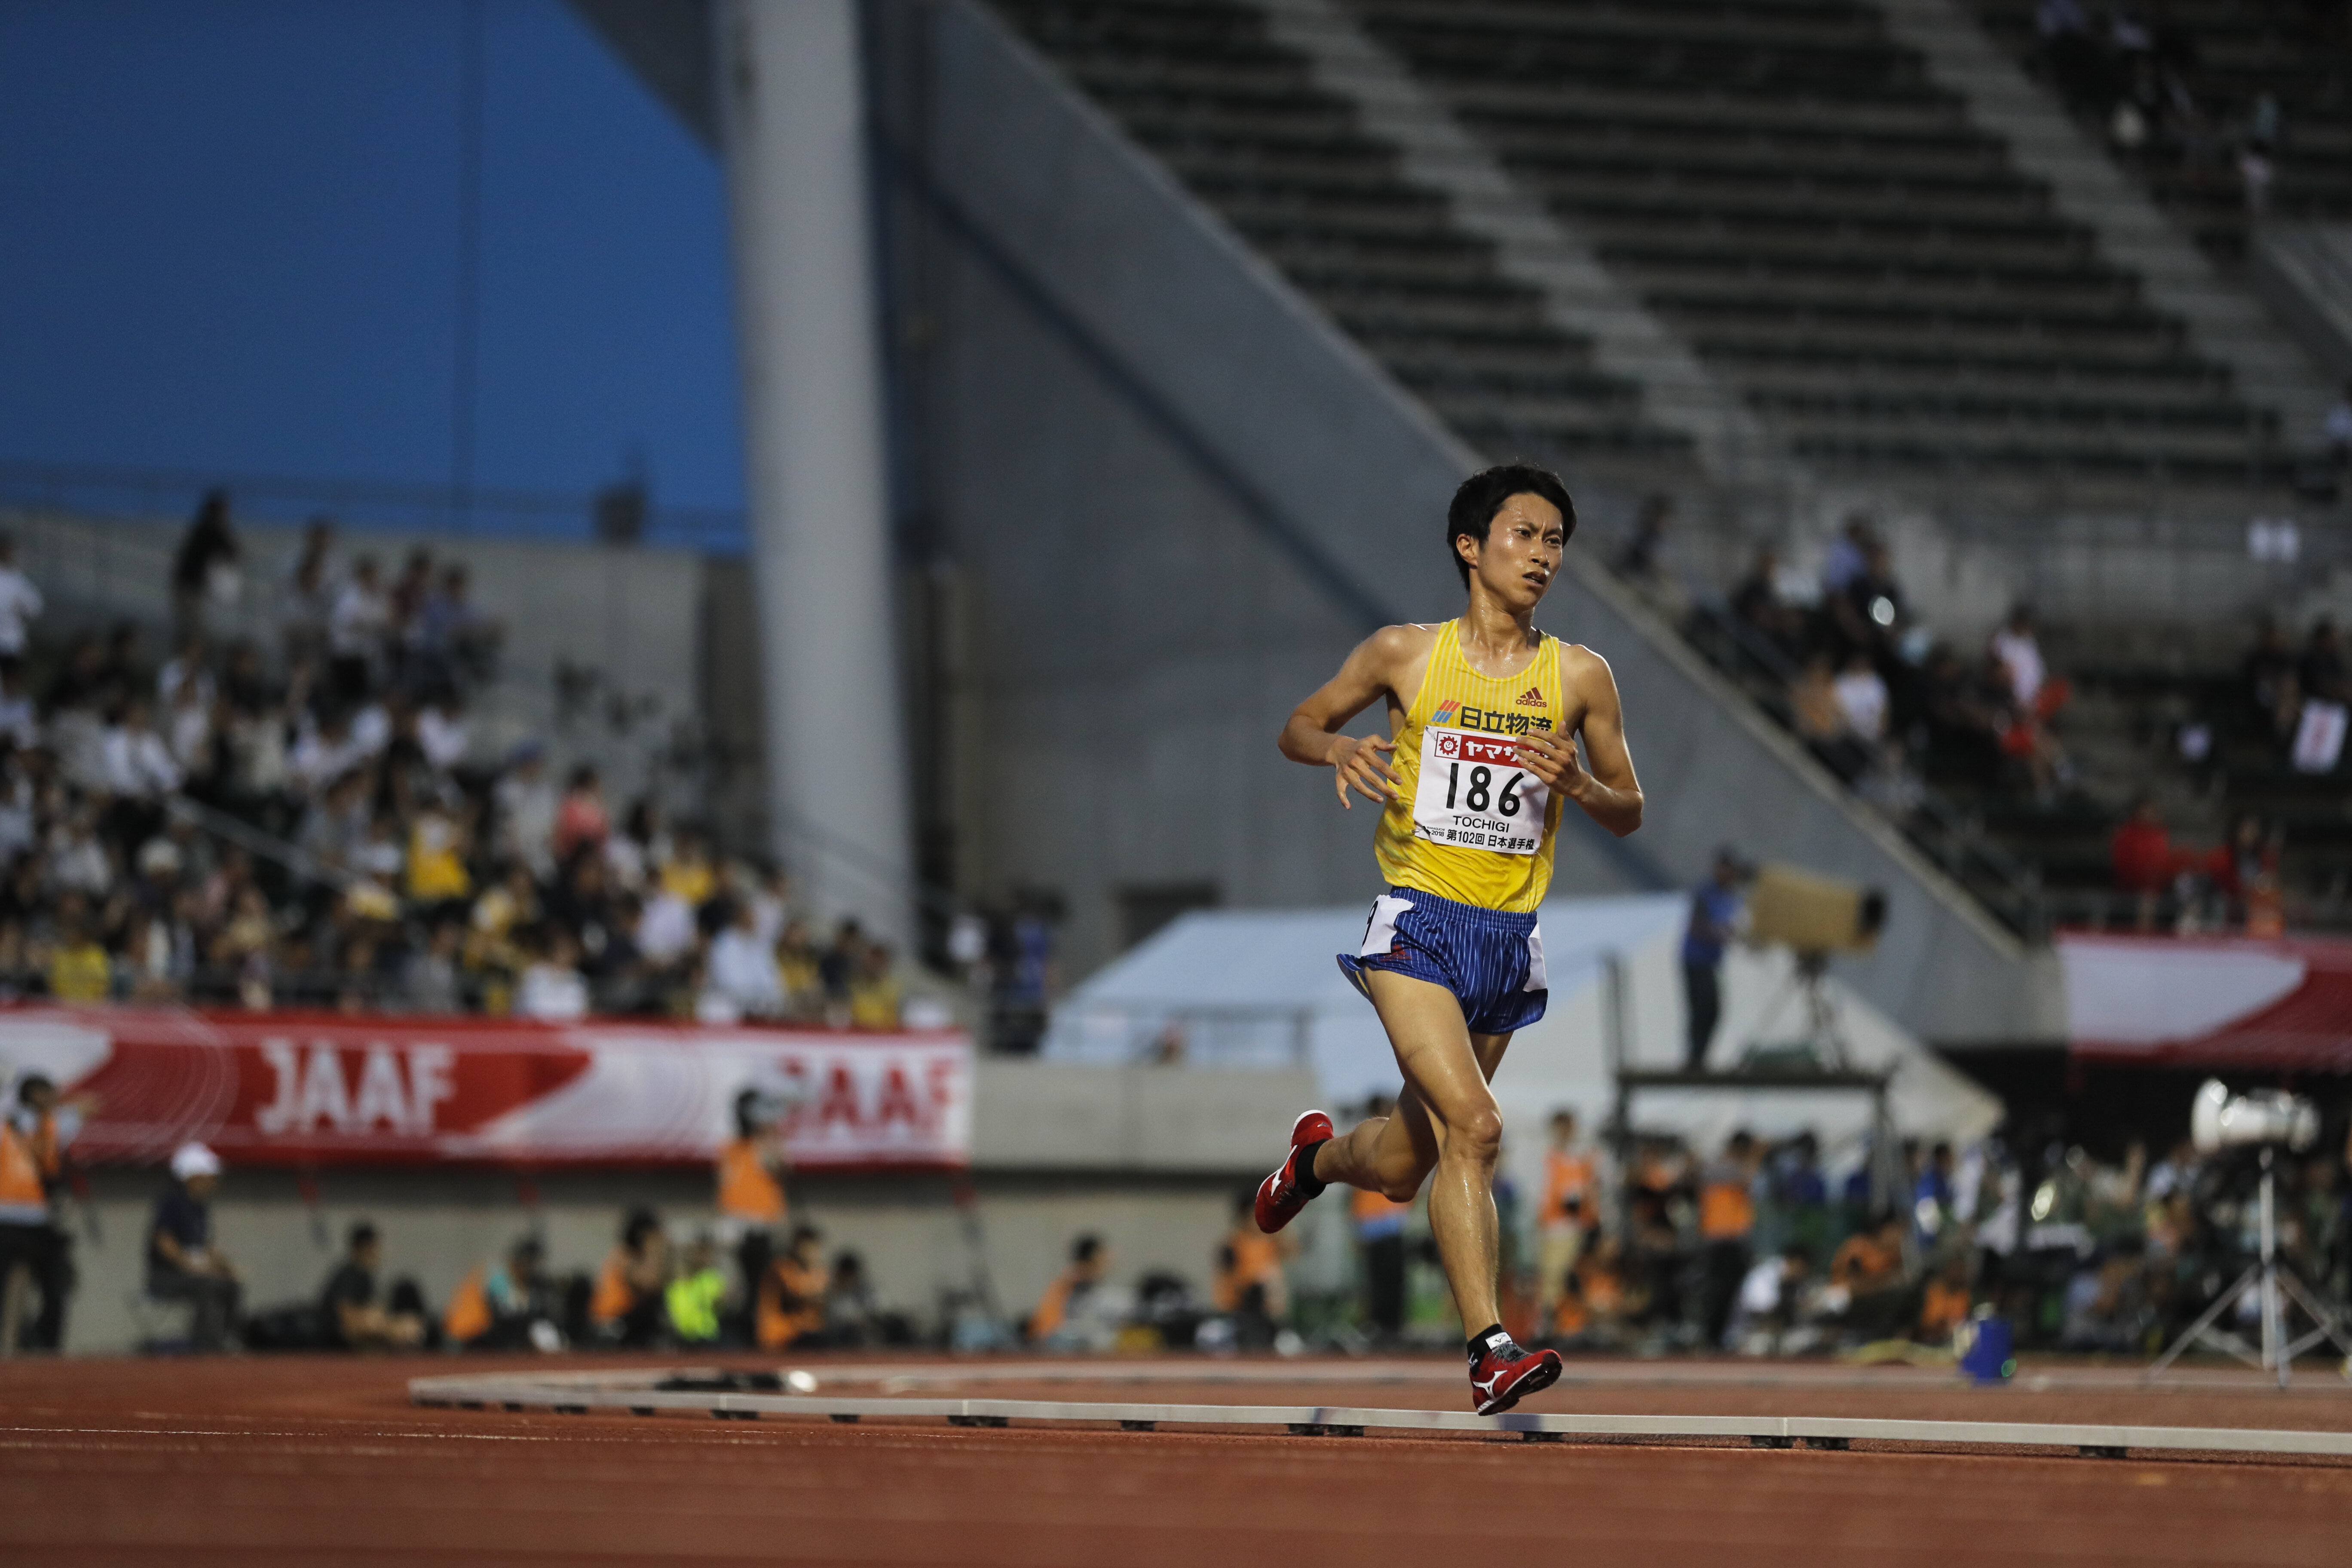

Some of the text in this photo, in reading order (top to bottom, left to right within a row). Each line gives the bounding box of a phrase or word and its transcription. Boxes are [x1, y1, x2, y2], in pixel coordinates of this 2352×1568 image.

[1516, 699, 1547, 708] adidas
[1460, 706, 1553, 735] 日立物流
[1446, 763, 1524, 817] 186
[1453, 816, 1510, 833] TOCHIGI
[1446, 829, 1535, 850] 第102回 日本選手権
[257, 1037, 456, 1137] JAAF
